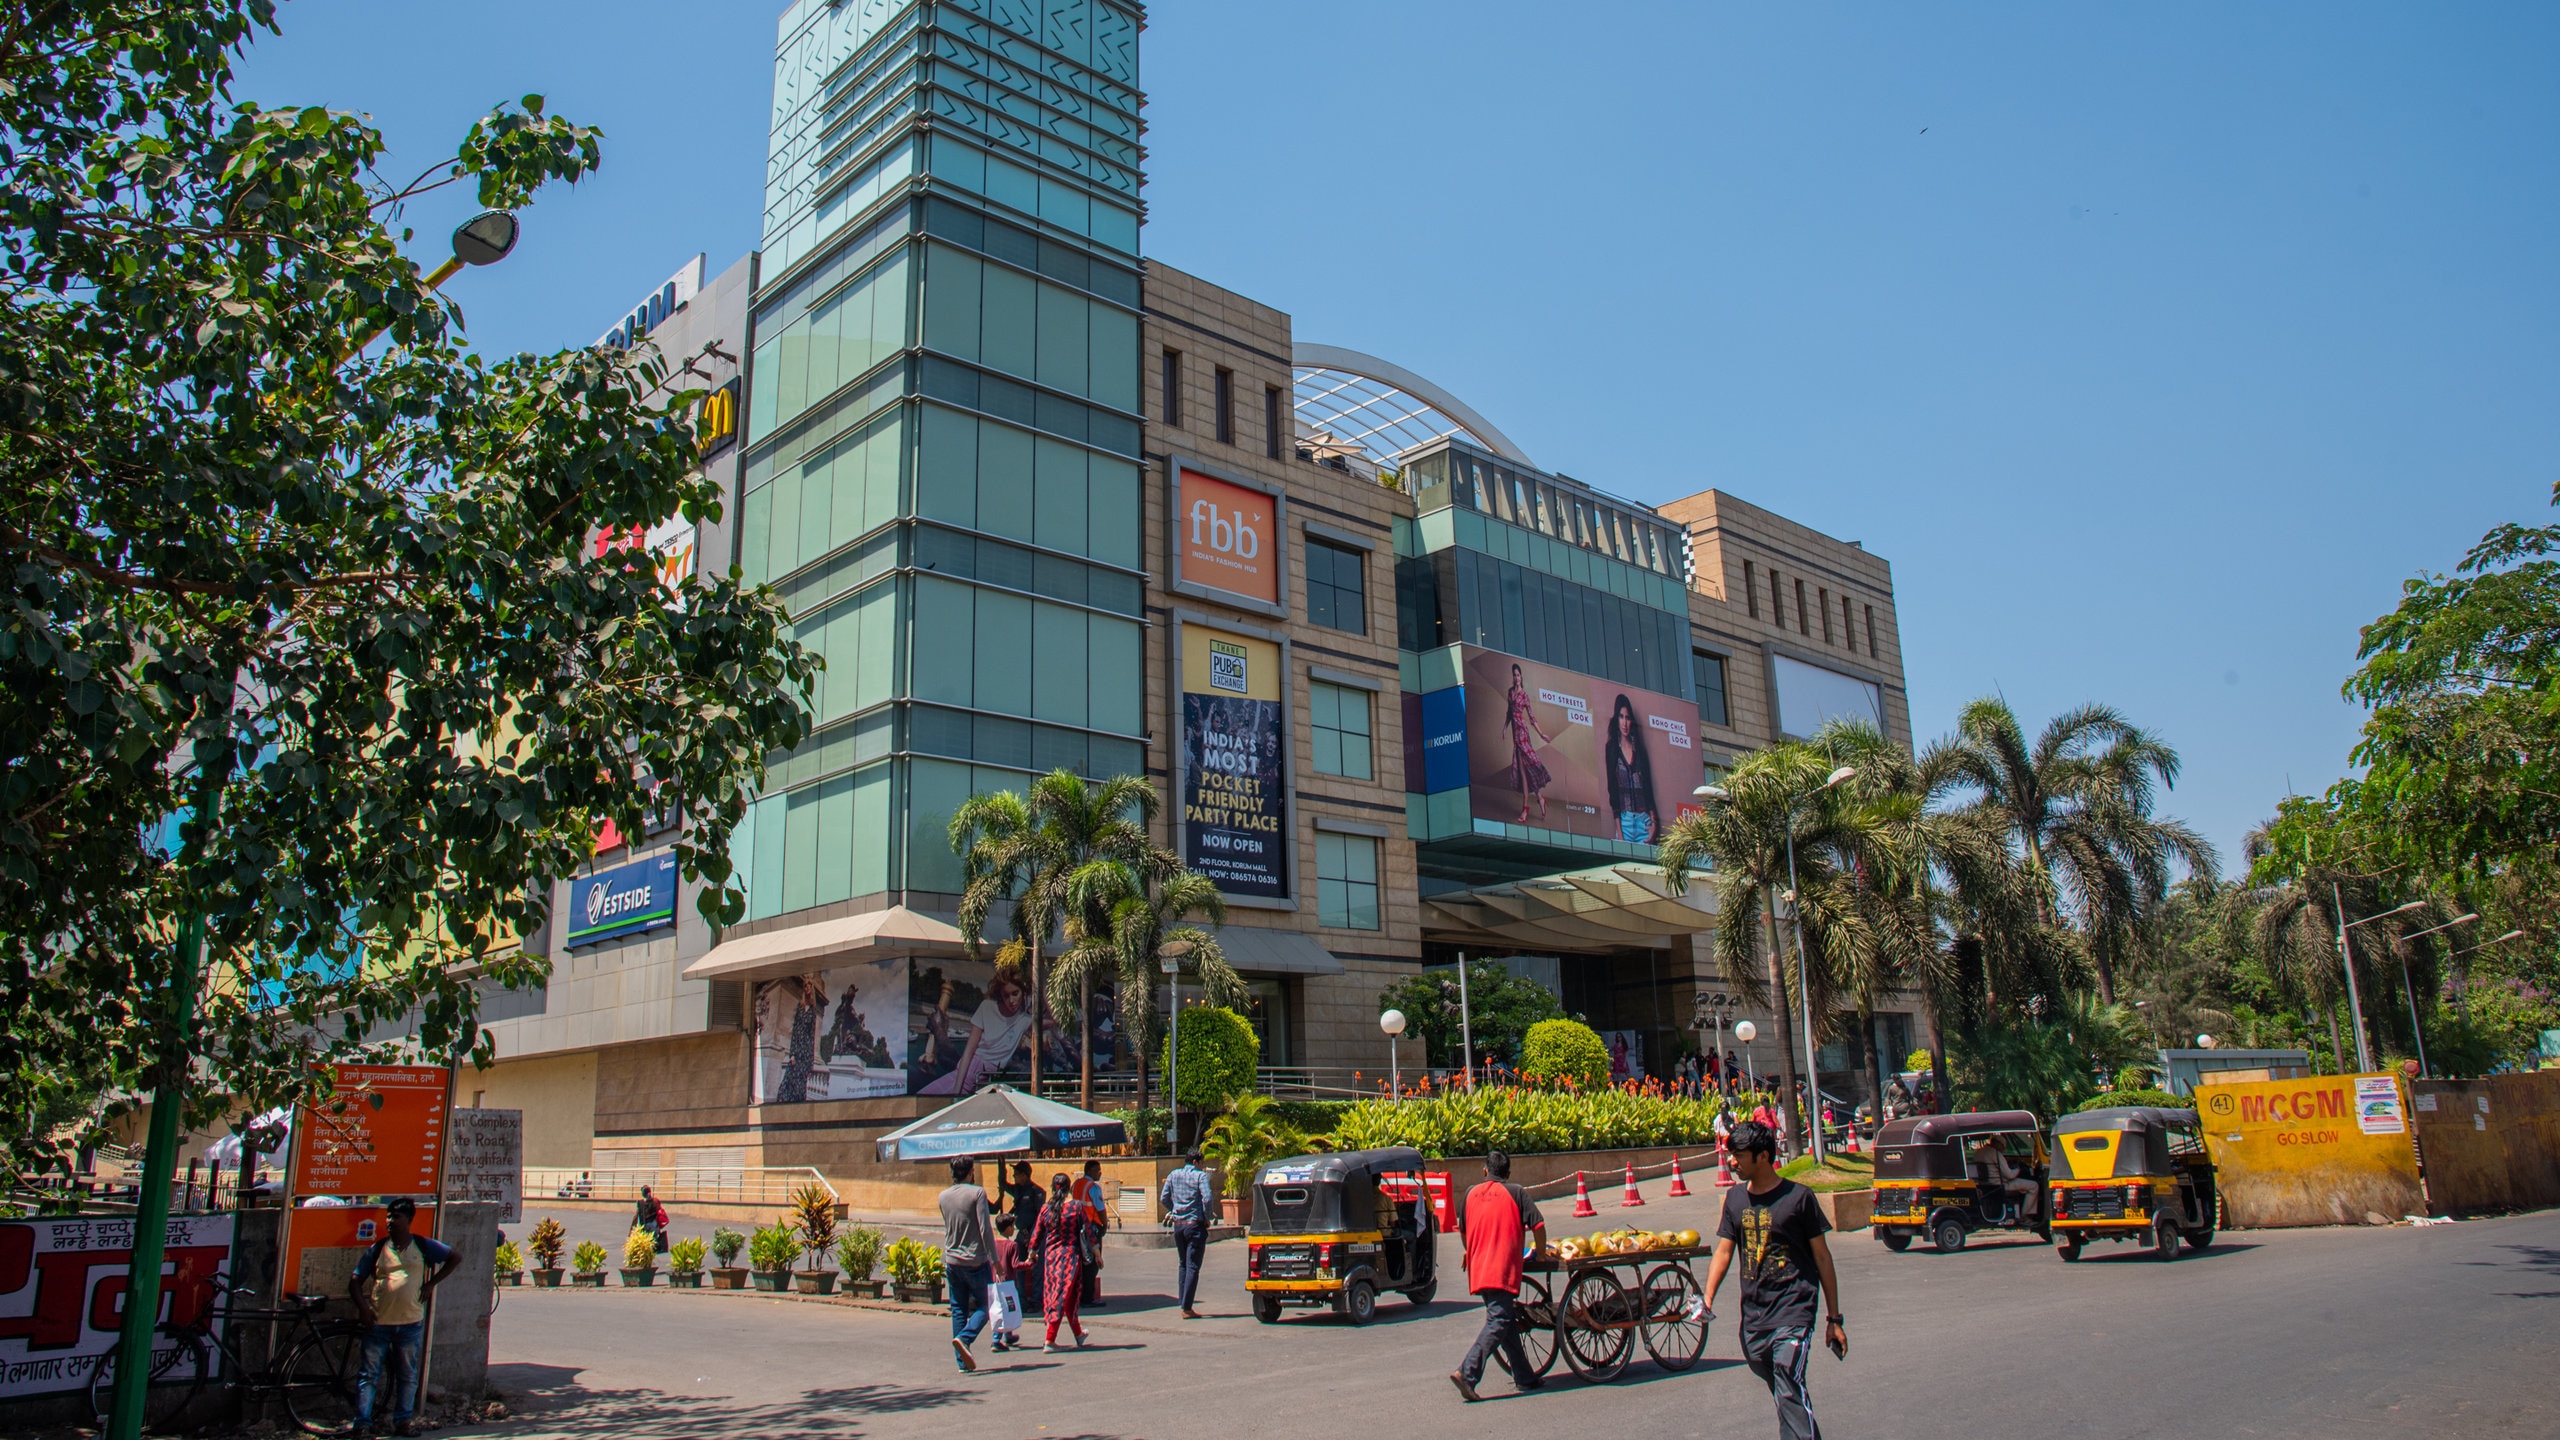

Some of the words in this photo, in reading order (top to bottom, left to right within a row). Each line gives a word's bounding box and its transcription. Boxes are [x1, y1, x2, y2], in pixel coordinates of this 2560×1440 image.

[1190, 499, 1258, 559] fbb
[1192, 551, 1214, 562] INDIA'S
[1216, 557, 1243, 569] FASHION
[1244, 565, 1257, 574] HUB
[1216, 643, 1240, 656] THANE
[1213, 655, 1232, 674] PUB
[1213, 674, 1244, 690] EXCHANGE
[1542, 692, 1555, 701] HOT
[1558, 696, 1585, 708] STREETS
[1570, 713, 1589, 723] LOOK
[1651, 717, 1669, 729] BOHO
[1670, 722, 1685, 733] CHIC
[1203, 730, 1256, 753] INDIA'S
[1433, 732, 1462, 747] KORUM
[1671, 735, 1689, 745] LOOK
[1204, 748, 1258, 775] MOST
[1202, 771, 1260, 795] POCKET
[1198, 788, 1264, 813] FRIENDLY
[1185, 804, 1230, 825] PARTY
[1234, 812, 1278, 833] PLACE
[1202, 834, 1230, 849] NOW
[1233, 838, 1263, 853] OPEN
[1199, 857, 1211, 865] 2ND
[1211, 858, 1231, 868] FLOOR,
[1232, 861, 1252, 870] KORUM
[1252, 863, 1267, 872] MALL
[1189, 867, 1207, 876] CALL
[1208, 869, 1229, 879] NOW:
[1230, 871, 1257, 883] 086574
[1258, 875, 1278, 885] 06316
[587, 880, 651, 925] WESTSIDE
[343, 1067, 359, 1080] ठाणे
[420, 1071, 435, 1083] ठाणे
[2213, 1096, 2230, 1110] 41
[2240, 1089, 2347, 1123] MCGM
[957, 1118, 1005, 1129] MOCHI
[1069, 1128, 1095, 1139] MOCHI
[2277, 1132, 2298, 1146] GO
[2301, 1130, 2339, 1145] SLOW
[918, 1138, 967, 1151] GROUND
[971, 1134, 1009, 1147] FLOOR
[451, 1152, 514, 1168] oroughfare
